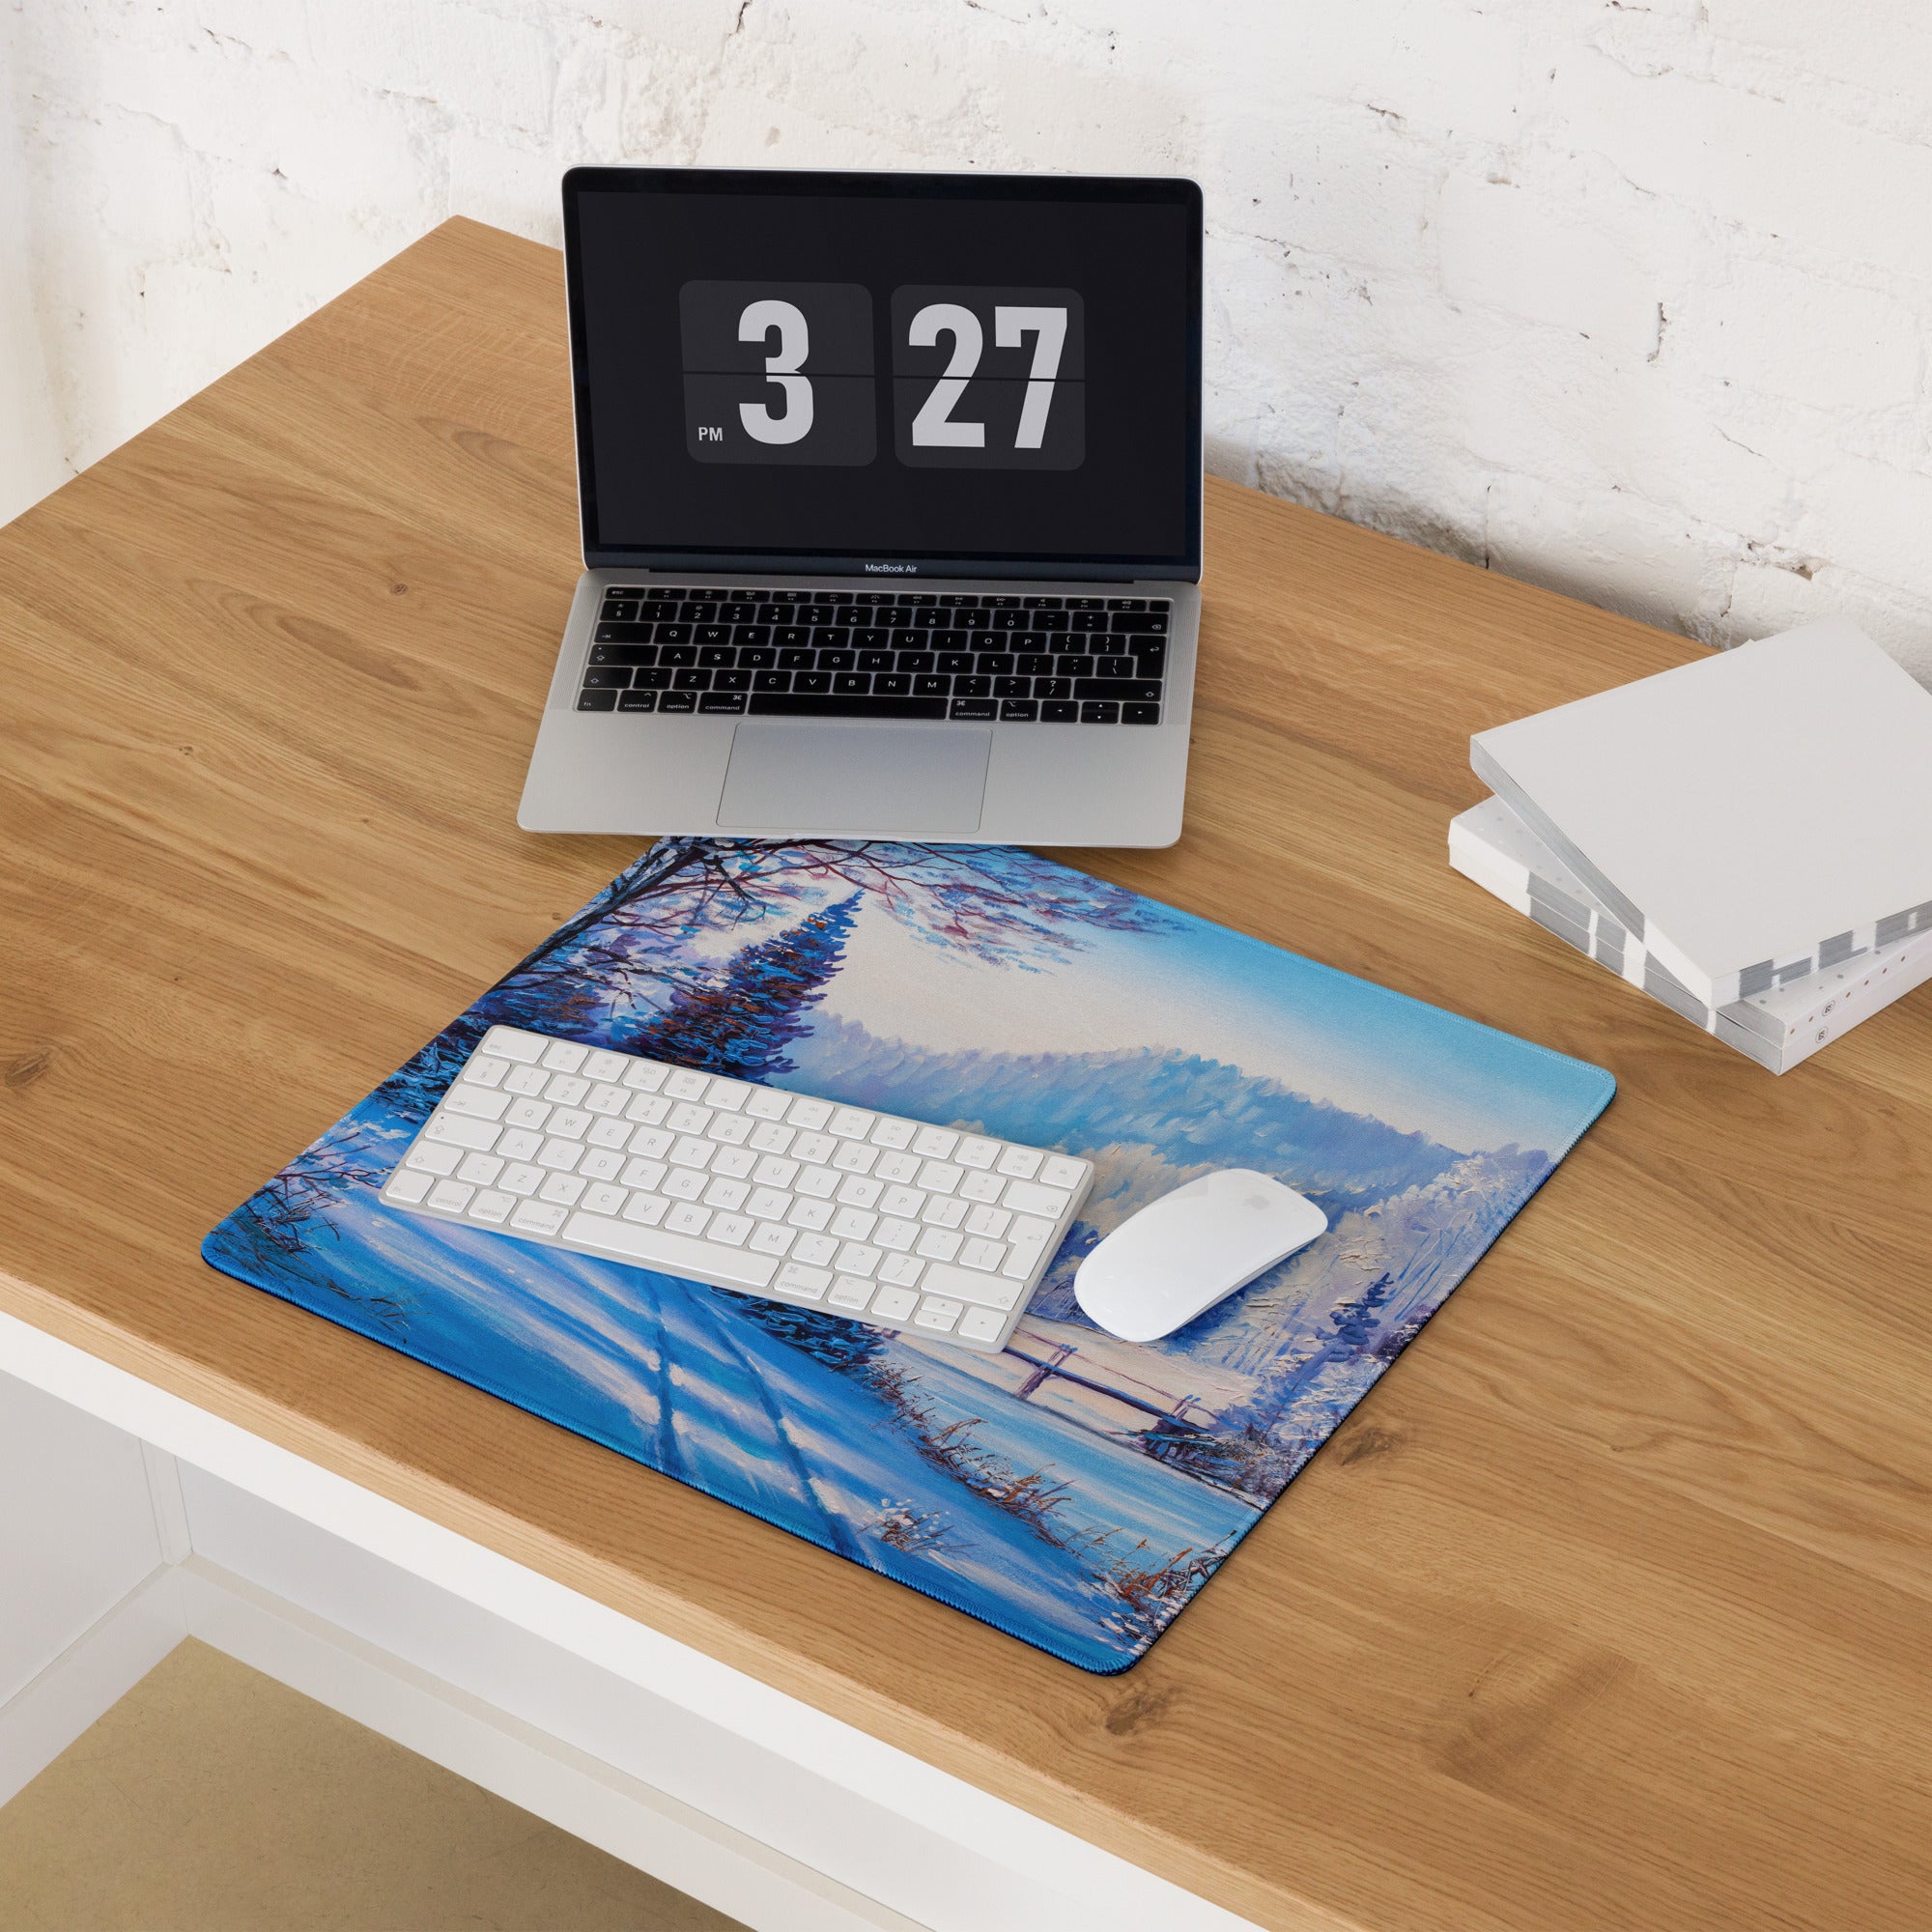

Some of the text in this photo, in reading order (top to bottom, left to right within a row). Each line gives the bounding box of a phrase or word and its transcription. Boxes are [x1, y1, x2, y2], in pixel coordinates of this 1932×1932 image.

[738, 299, 813, 444] 3
[909, 303, 1067, 448] 27
[698, 427, 723, 441] PM
[436, 1197, 462, 1207] control
[478, 1208, 502, 1217] option
[518, 1217, 555, 1230] command
[781, 1281, 818, 1293] command
[834, 1293, 859, 1304] option
